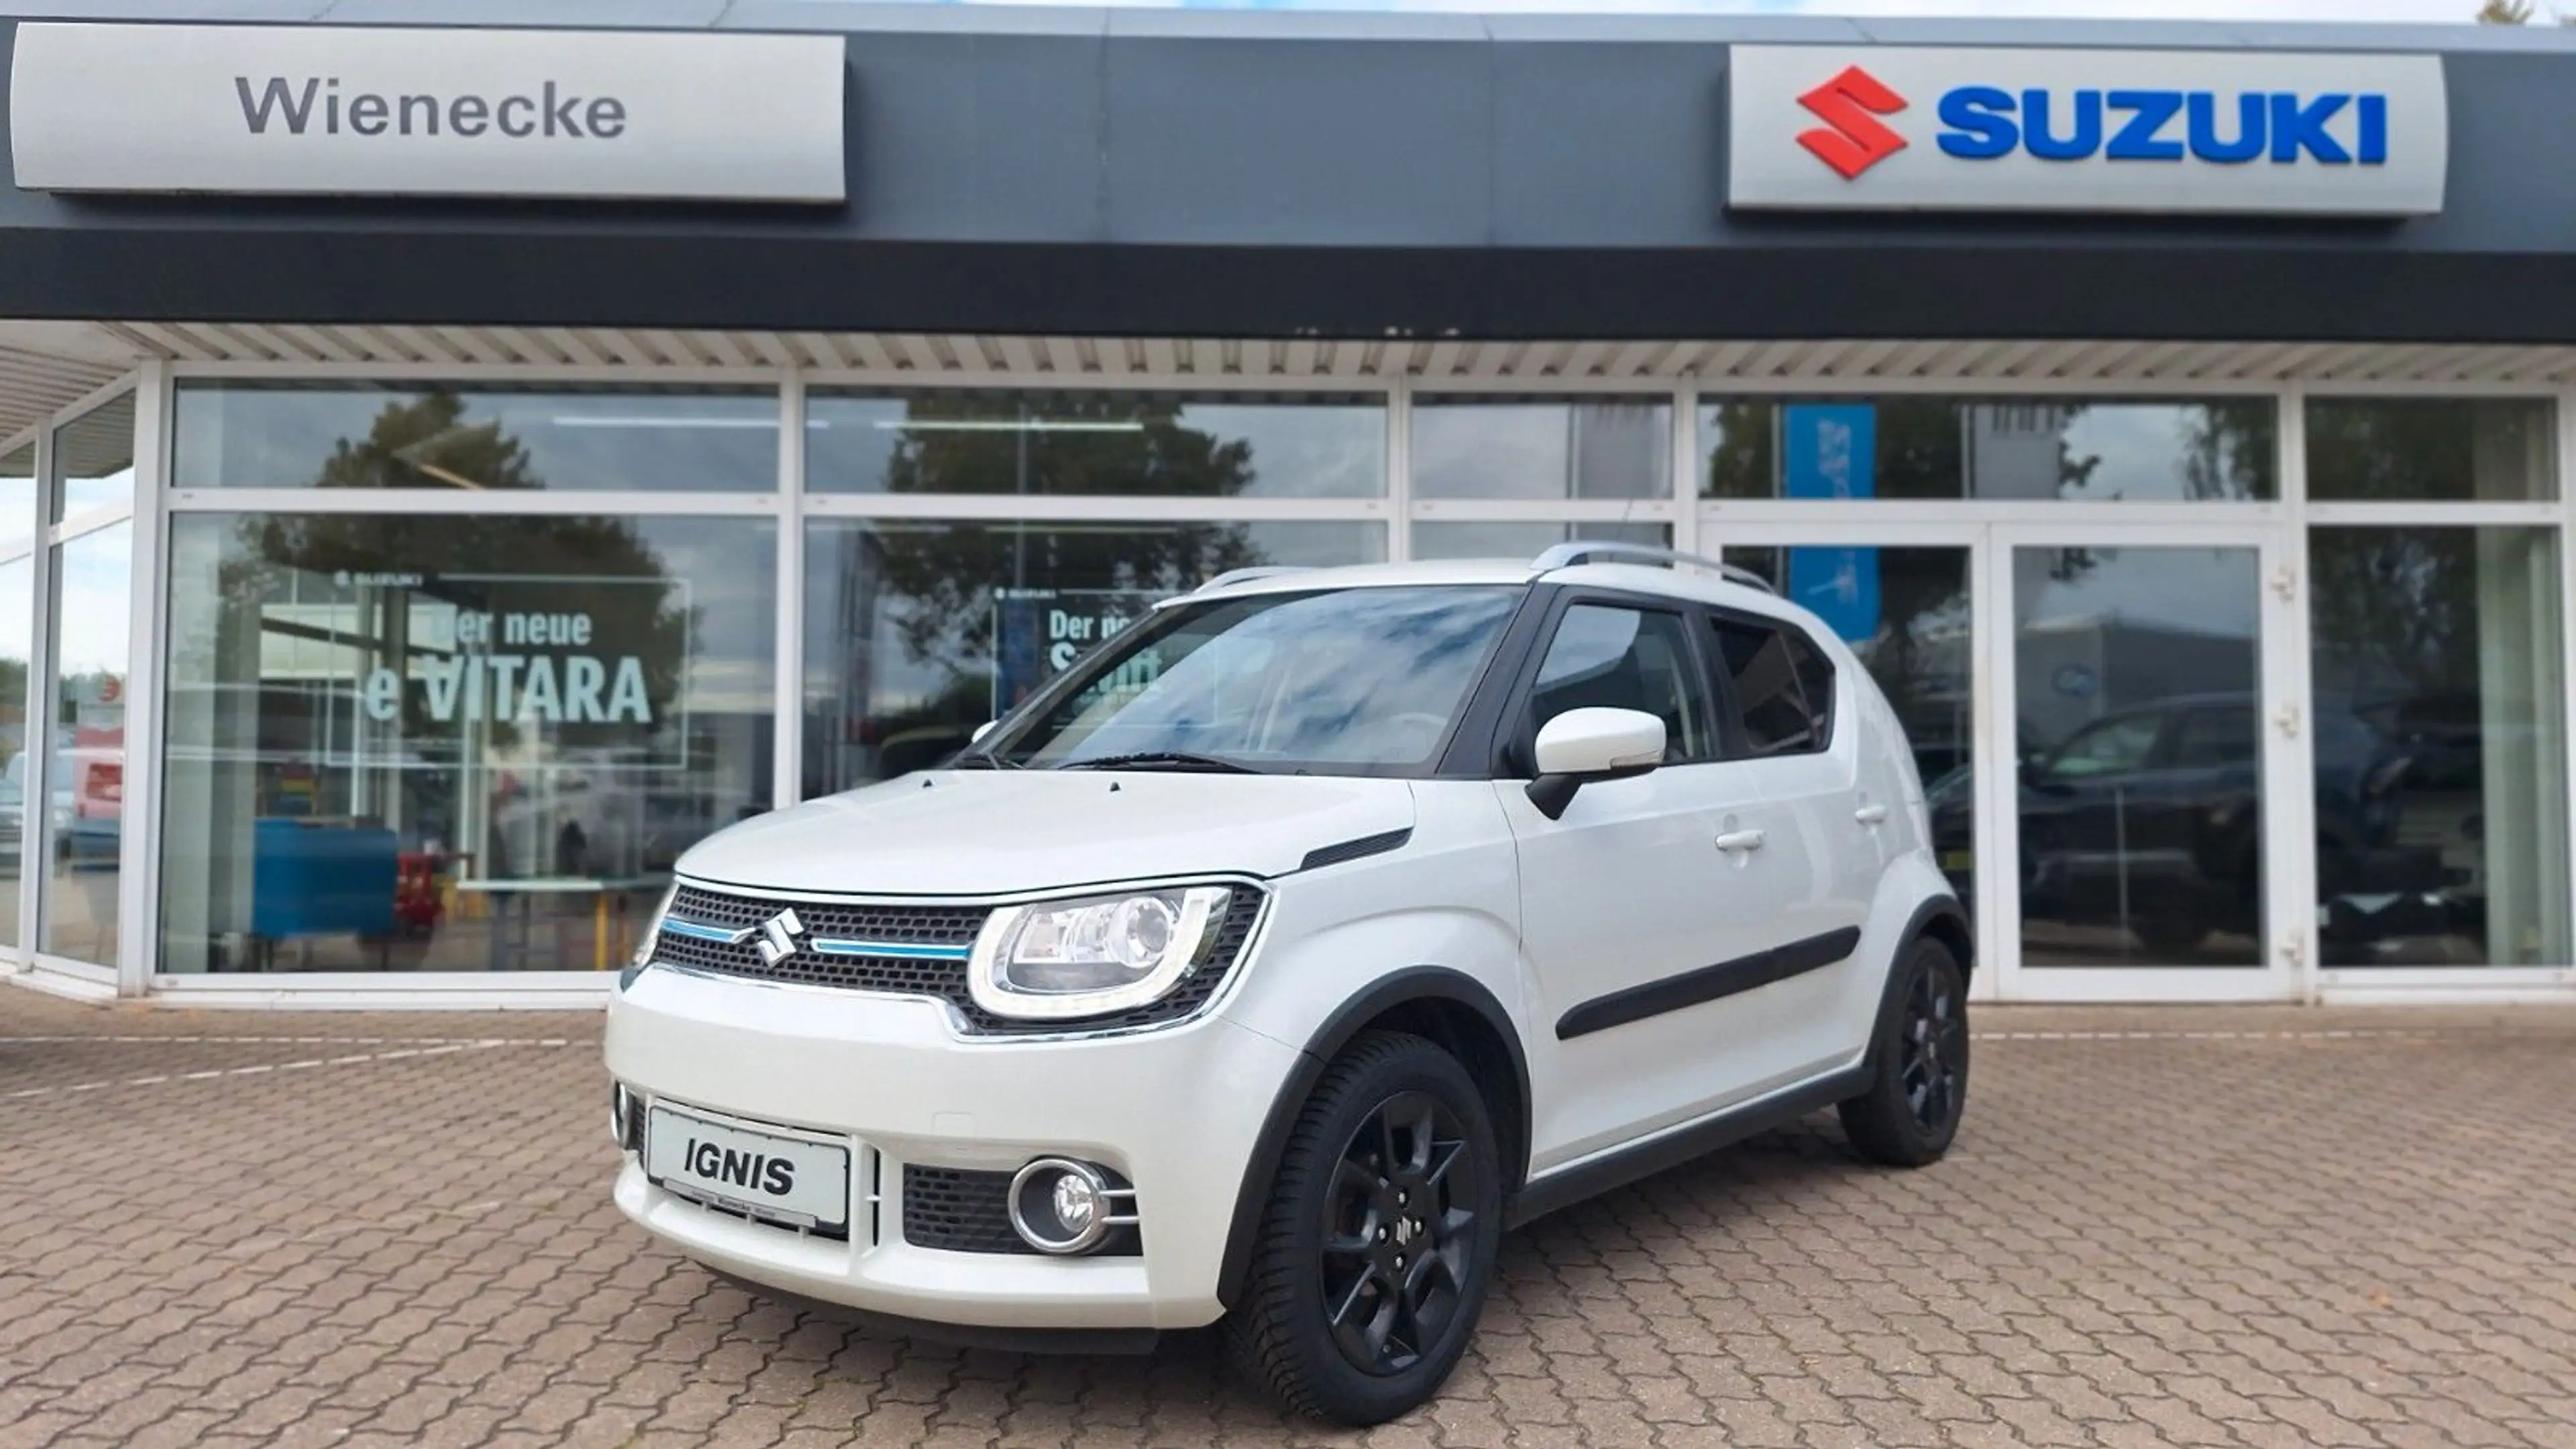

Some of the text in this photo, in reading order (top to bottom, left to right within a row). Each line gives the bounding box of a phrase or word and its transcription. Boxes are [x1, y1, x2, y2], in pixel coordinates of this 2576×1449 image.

[235, 76, 627, 139] Wienecke
[1936, 86, 2387, 164] SUZUKI
[431, 608, 592, 645] er neue
[1050, 609, 1094, 640] Der
[367, 654, 653, 723] e VITARA
[684, 1138, 795, 1195] IGNIS
